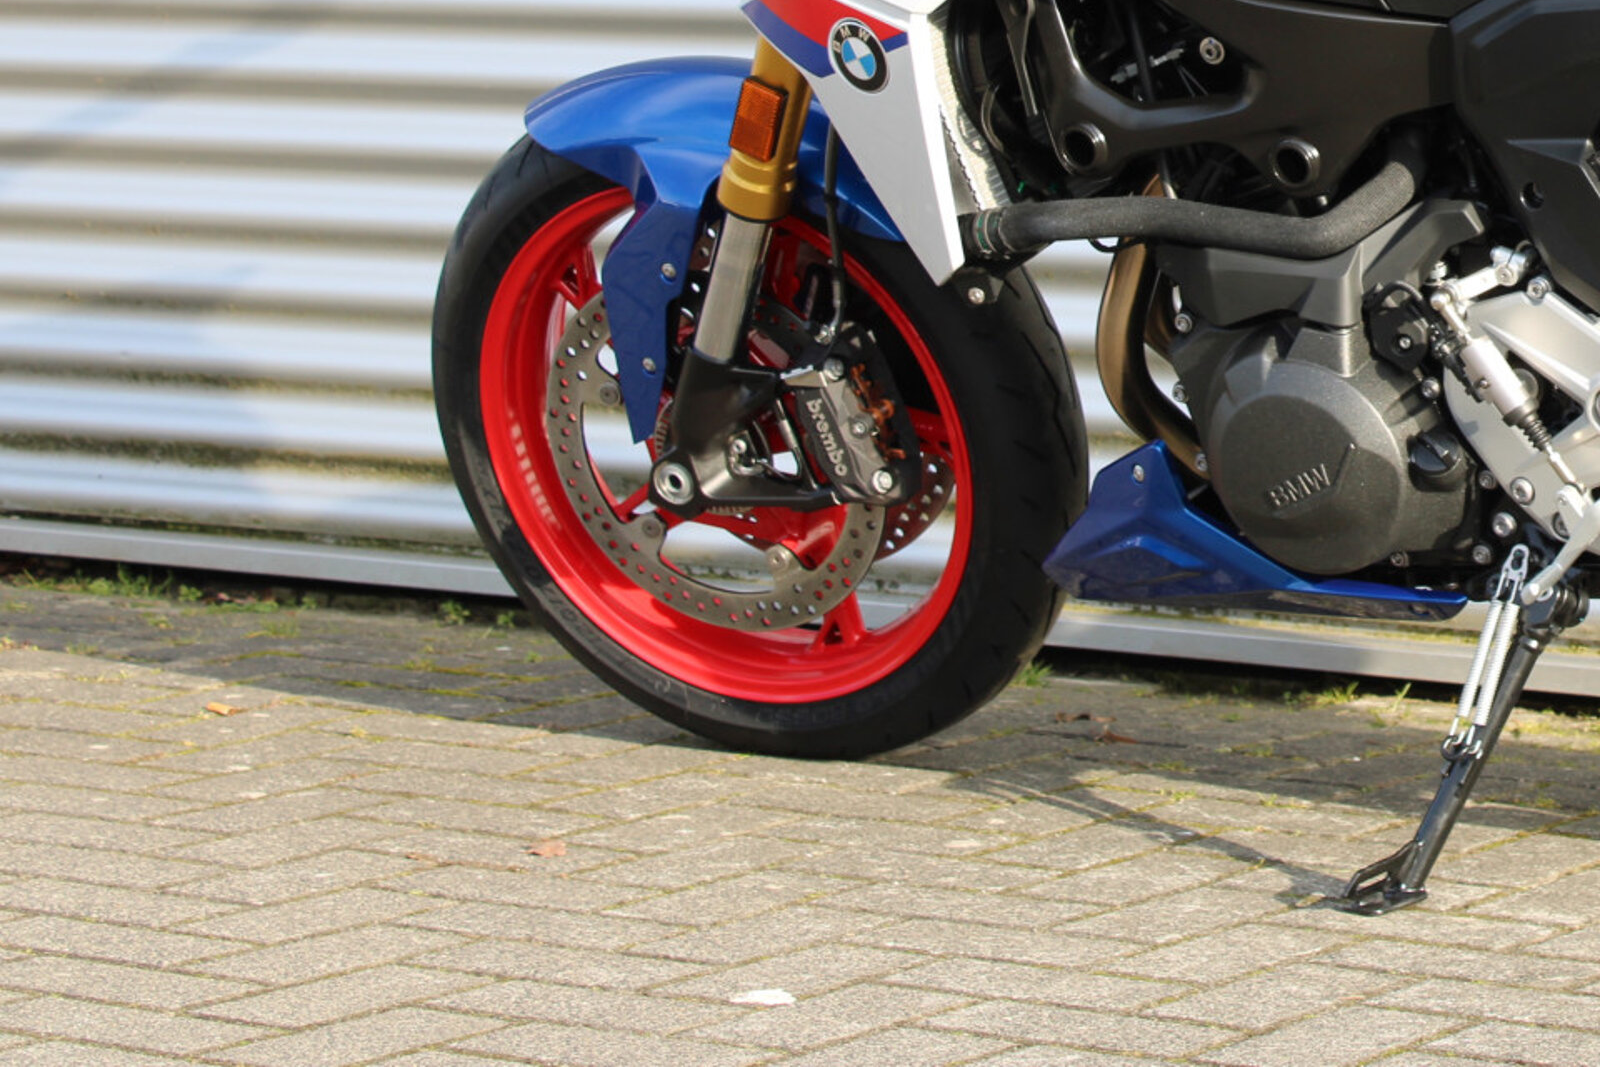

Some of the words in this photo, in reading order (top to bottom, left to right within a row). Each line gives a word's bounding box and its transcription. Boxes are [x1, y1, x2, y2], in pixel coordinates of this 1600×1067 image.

[833, 25, 870, 53] BMW
[806, 398, 847, 476] brembo
[1269, 463, 1331, 507] BMW
